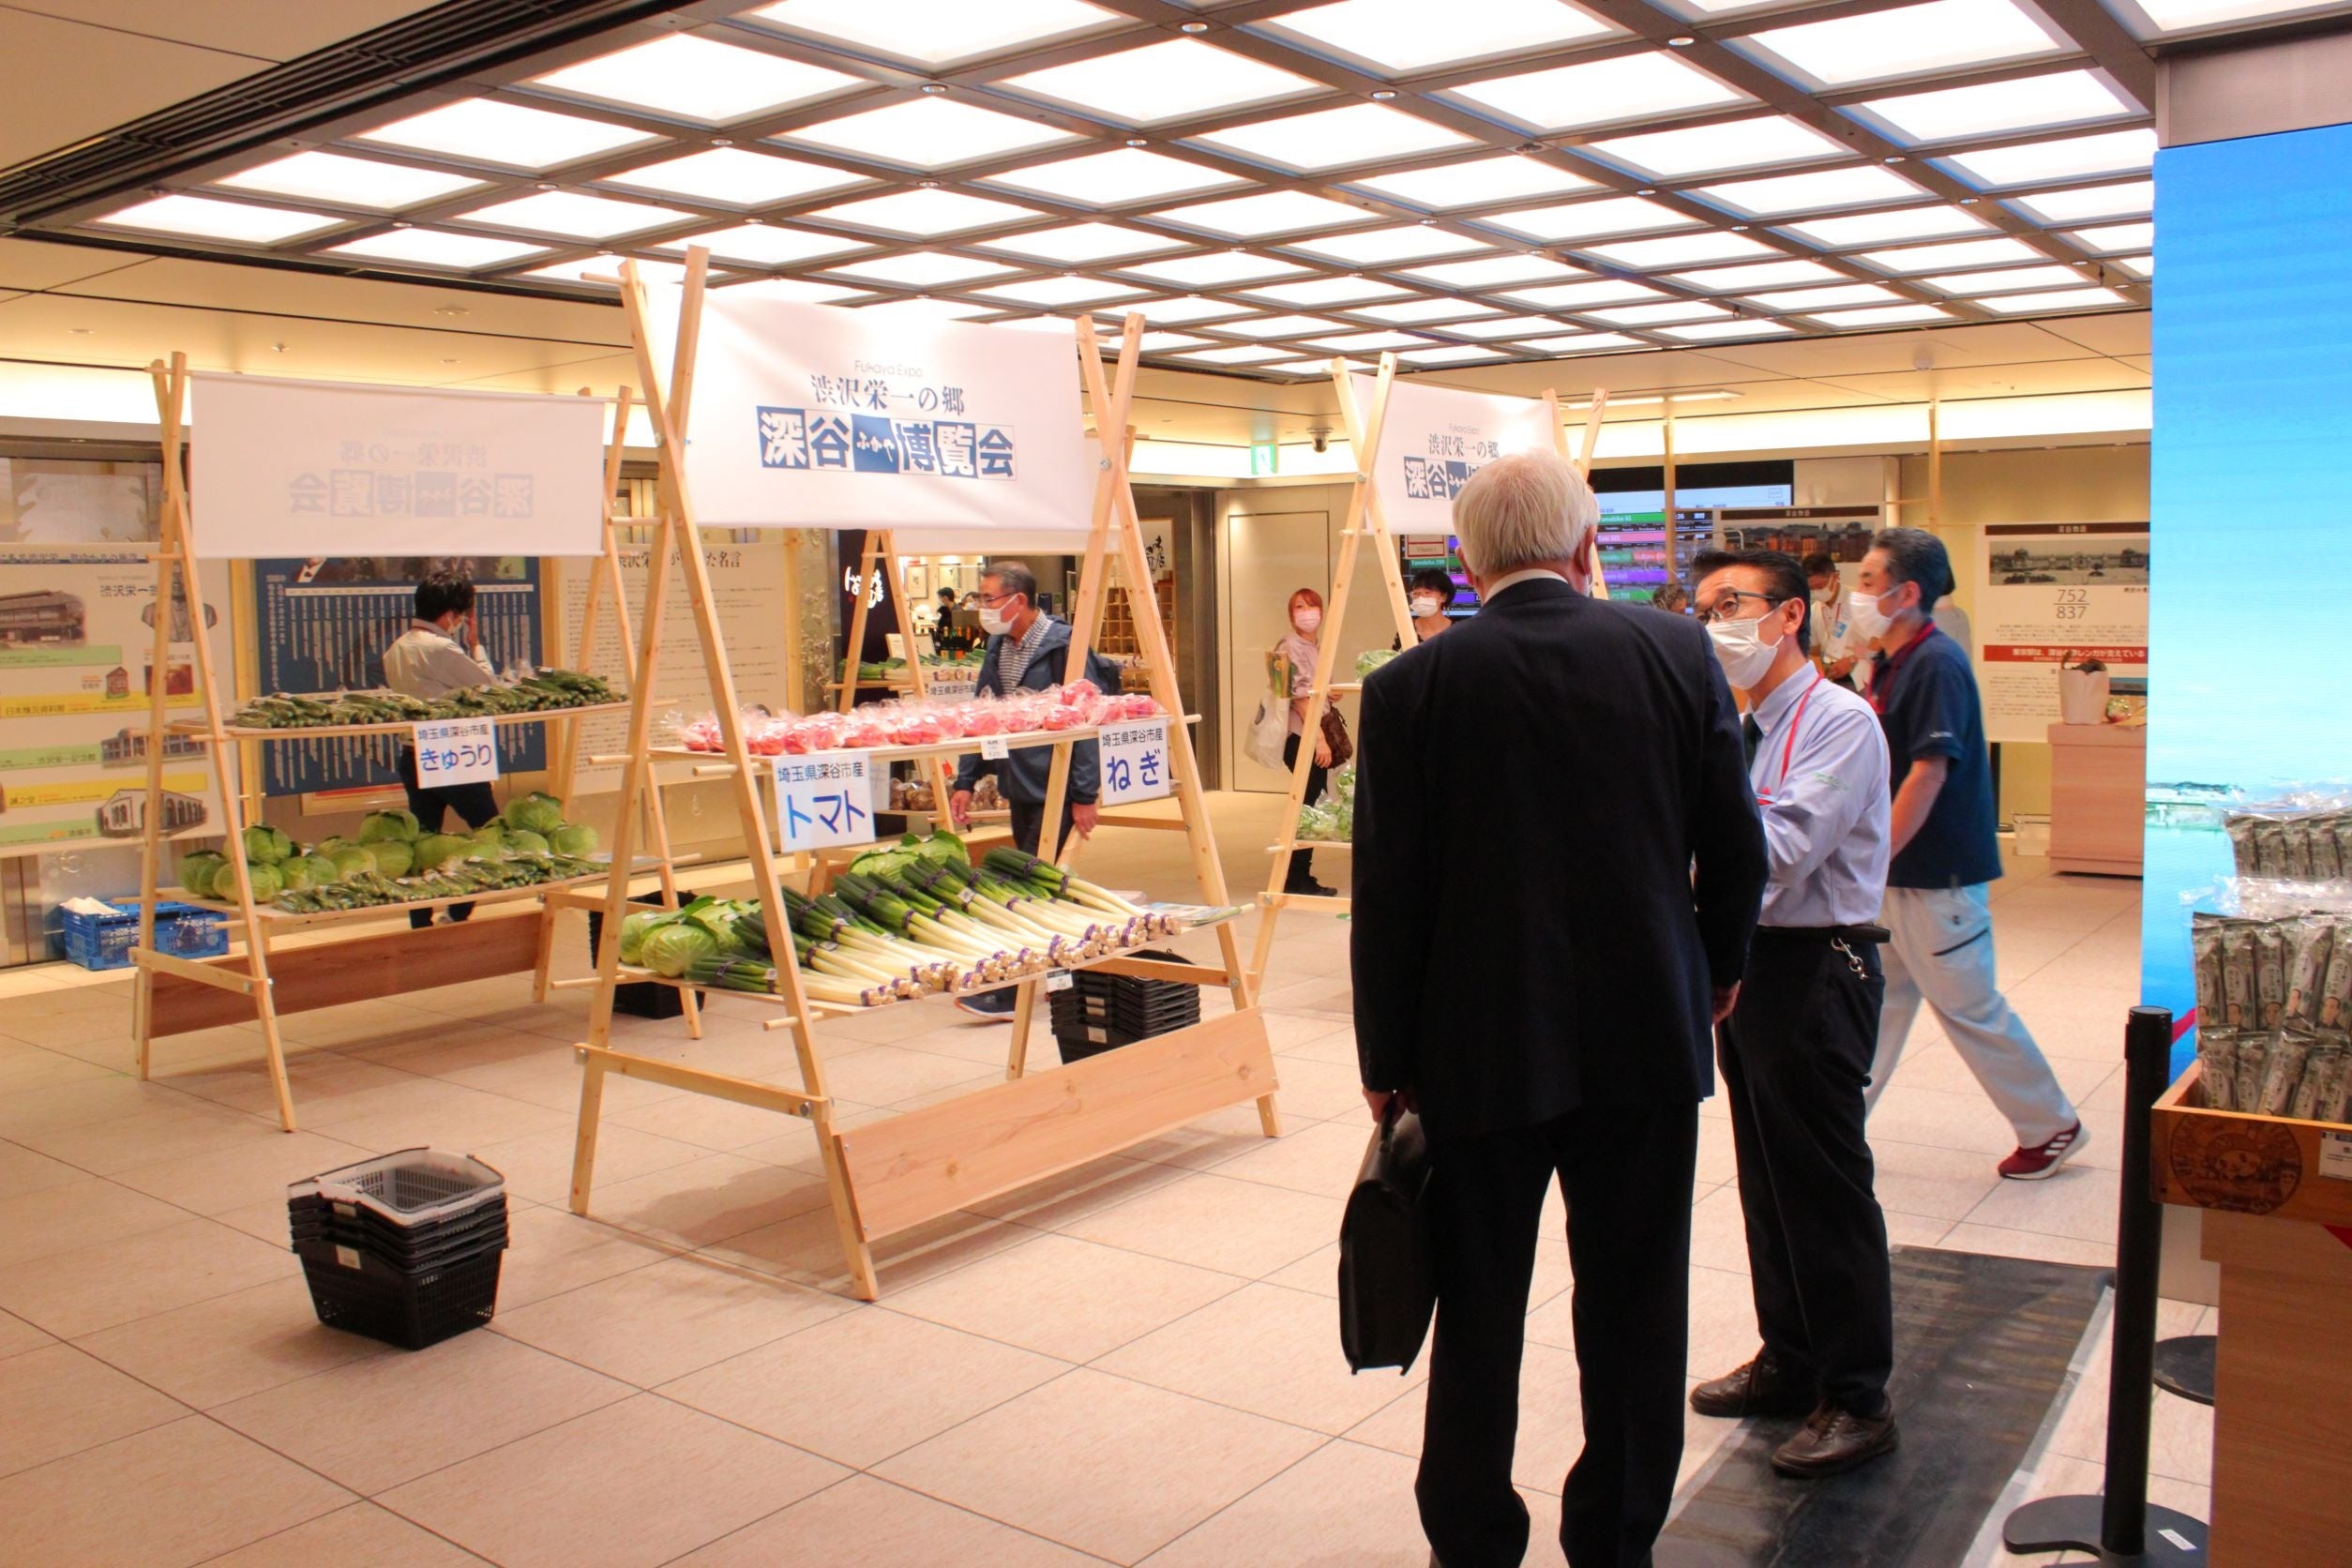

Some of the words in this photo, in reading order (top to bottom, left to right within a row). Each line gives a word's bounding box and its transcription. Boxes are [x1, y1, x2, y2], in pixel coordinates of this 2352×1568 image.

[810, 374, 965, 416] 渋沢栄一の郷
[1428, 433, 1500, 458] 渋沢栄一の郷
[2058, 588, 2087, 602] 752
[2056, 606, 2087, 620] 837
[418, 724, 490, 740] 埼玉県深谷市産
[1102, 728, 1164, 747] 埼玉県深谷市産
[420, 744, 491, 771] きゅうり
[777, 761, 864, 783] 埼玉県深谷市産
[1106, 747, 1162, 792] ねぎ
[787, 790, 866, 839] トマト
